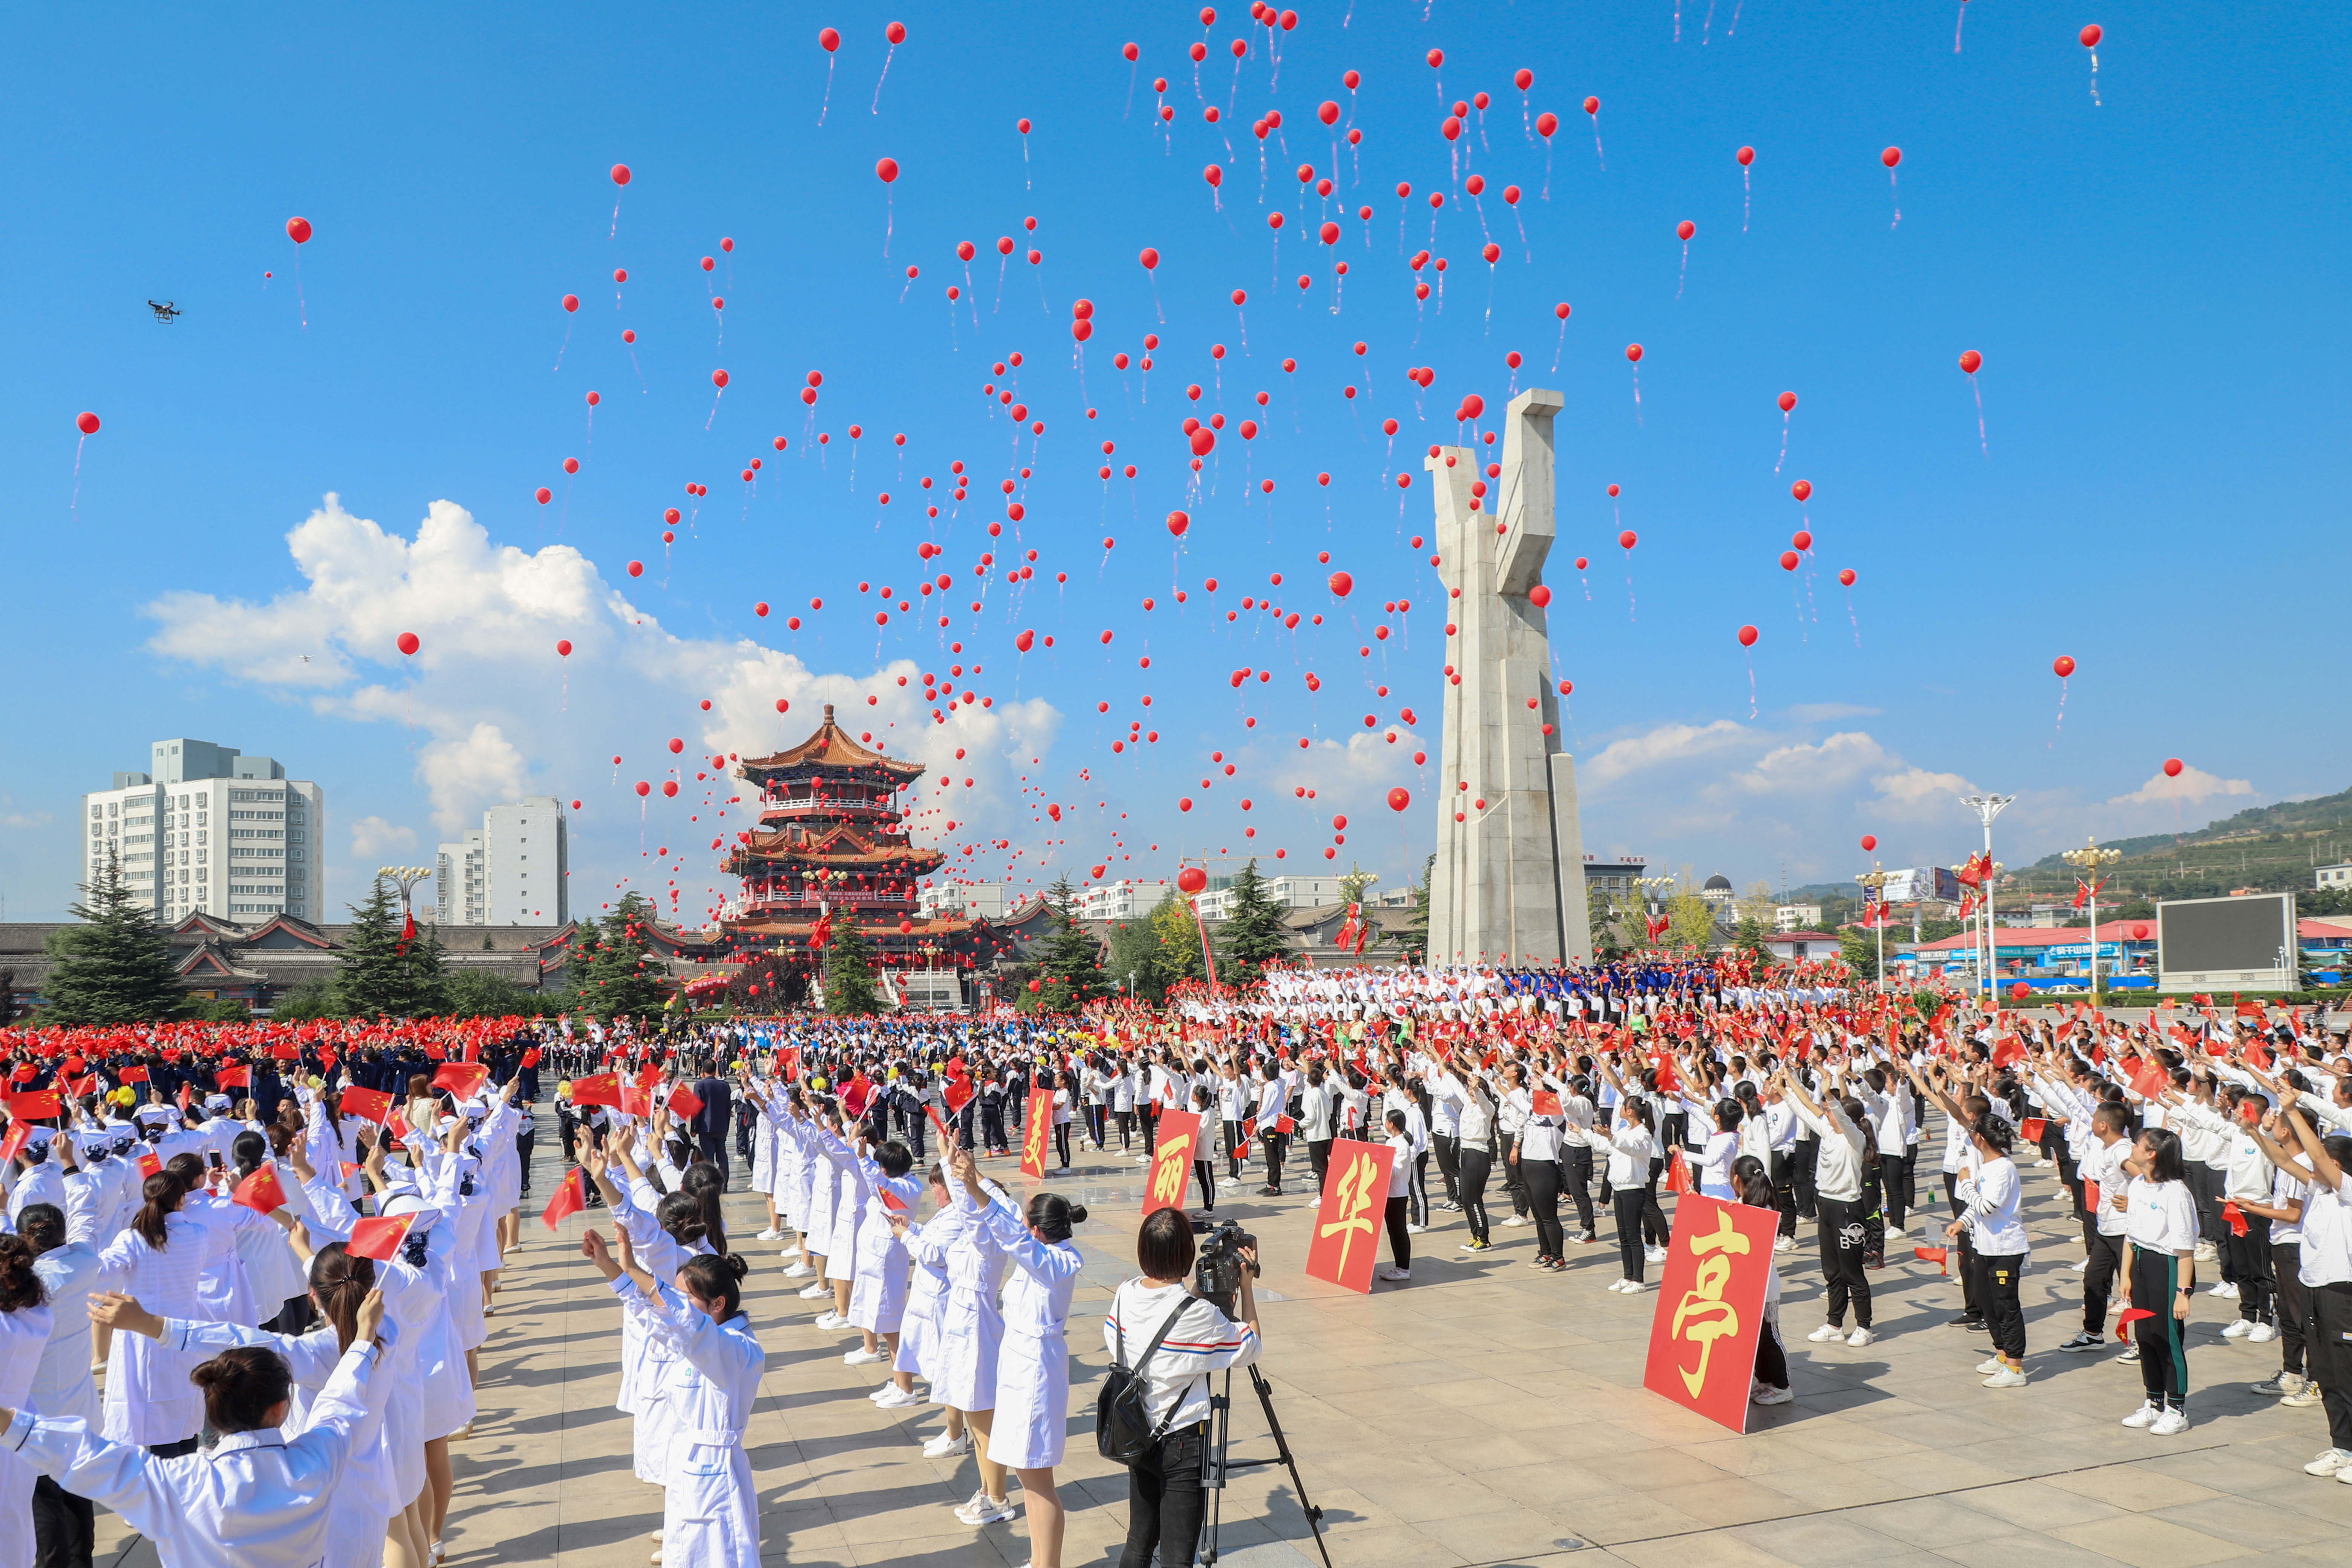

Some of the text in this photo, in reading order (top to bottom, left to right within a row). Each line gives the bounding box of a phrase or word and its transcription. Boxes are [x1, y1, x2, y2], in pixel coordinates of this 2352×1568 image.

[1024, 1092, 1045, 1177] 美
[1153, 1133, 1189, 1204] 丽
[1320, 1152, 1377, 1282] 华
[1672, 1205, 1750, 1400] 亭
